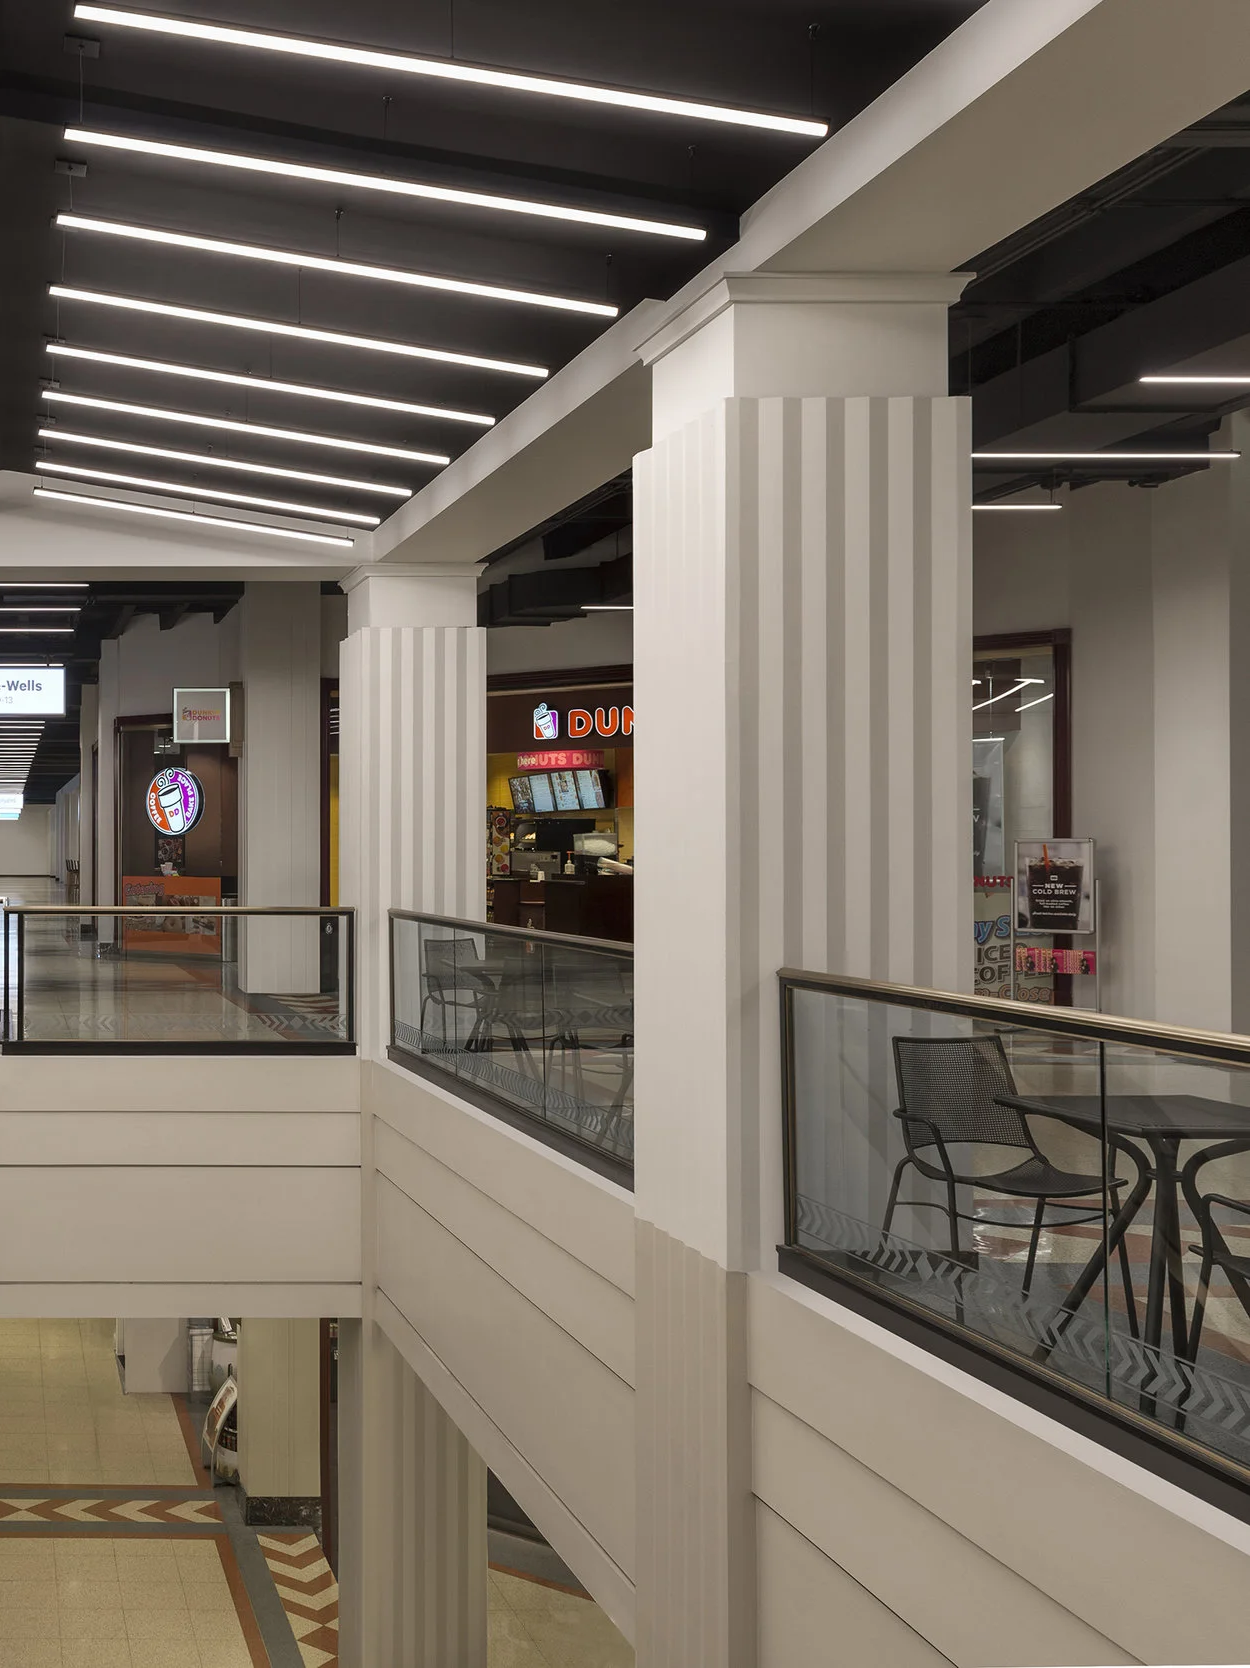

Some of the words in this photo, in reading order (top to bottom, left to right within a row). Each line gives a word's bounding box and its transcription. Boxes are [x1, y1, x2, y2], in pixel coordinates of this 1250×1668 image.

[177, 774, 193, 796] PLACE
[150, 792, 162, 823] COFFEE
[168, 808, 180, 818] DD
[185, 796, 194, 818] BAKE
